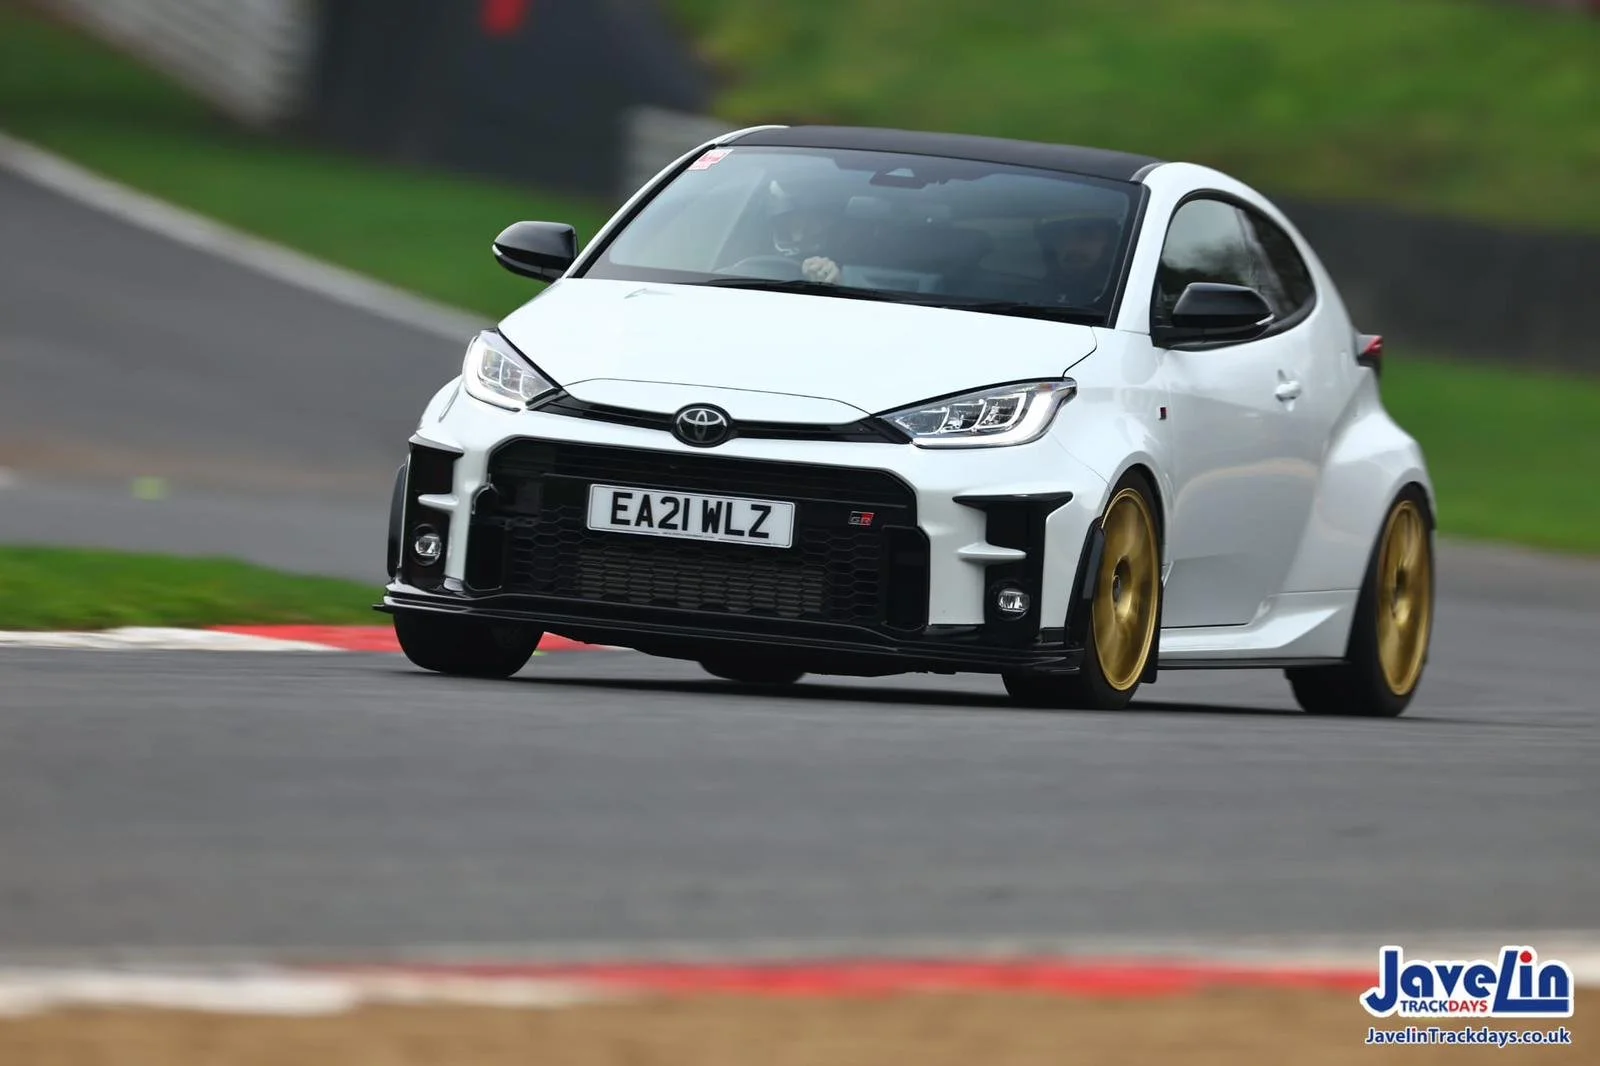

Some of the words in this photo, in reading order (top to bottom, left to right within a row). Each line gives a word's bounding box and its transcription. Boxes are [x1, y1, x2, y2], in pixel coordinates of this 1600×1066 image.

[610, 491, 690, 531] EA21
[701, 500, 772, 539] WLZ
[849, 514, 872, 526] GR
